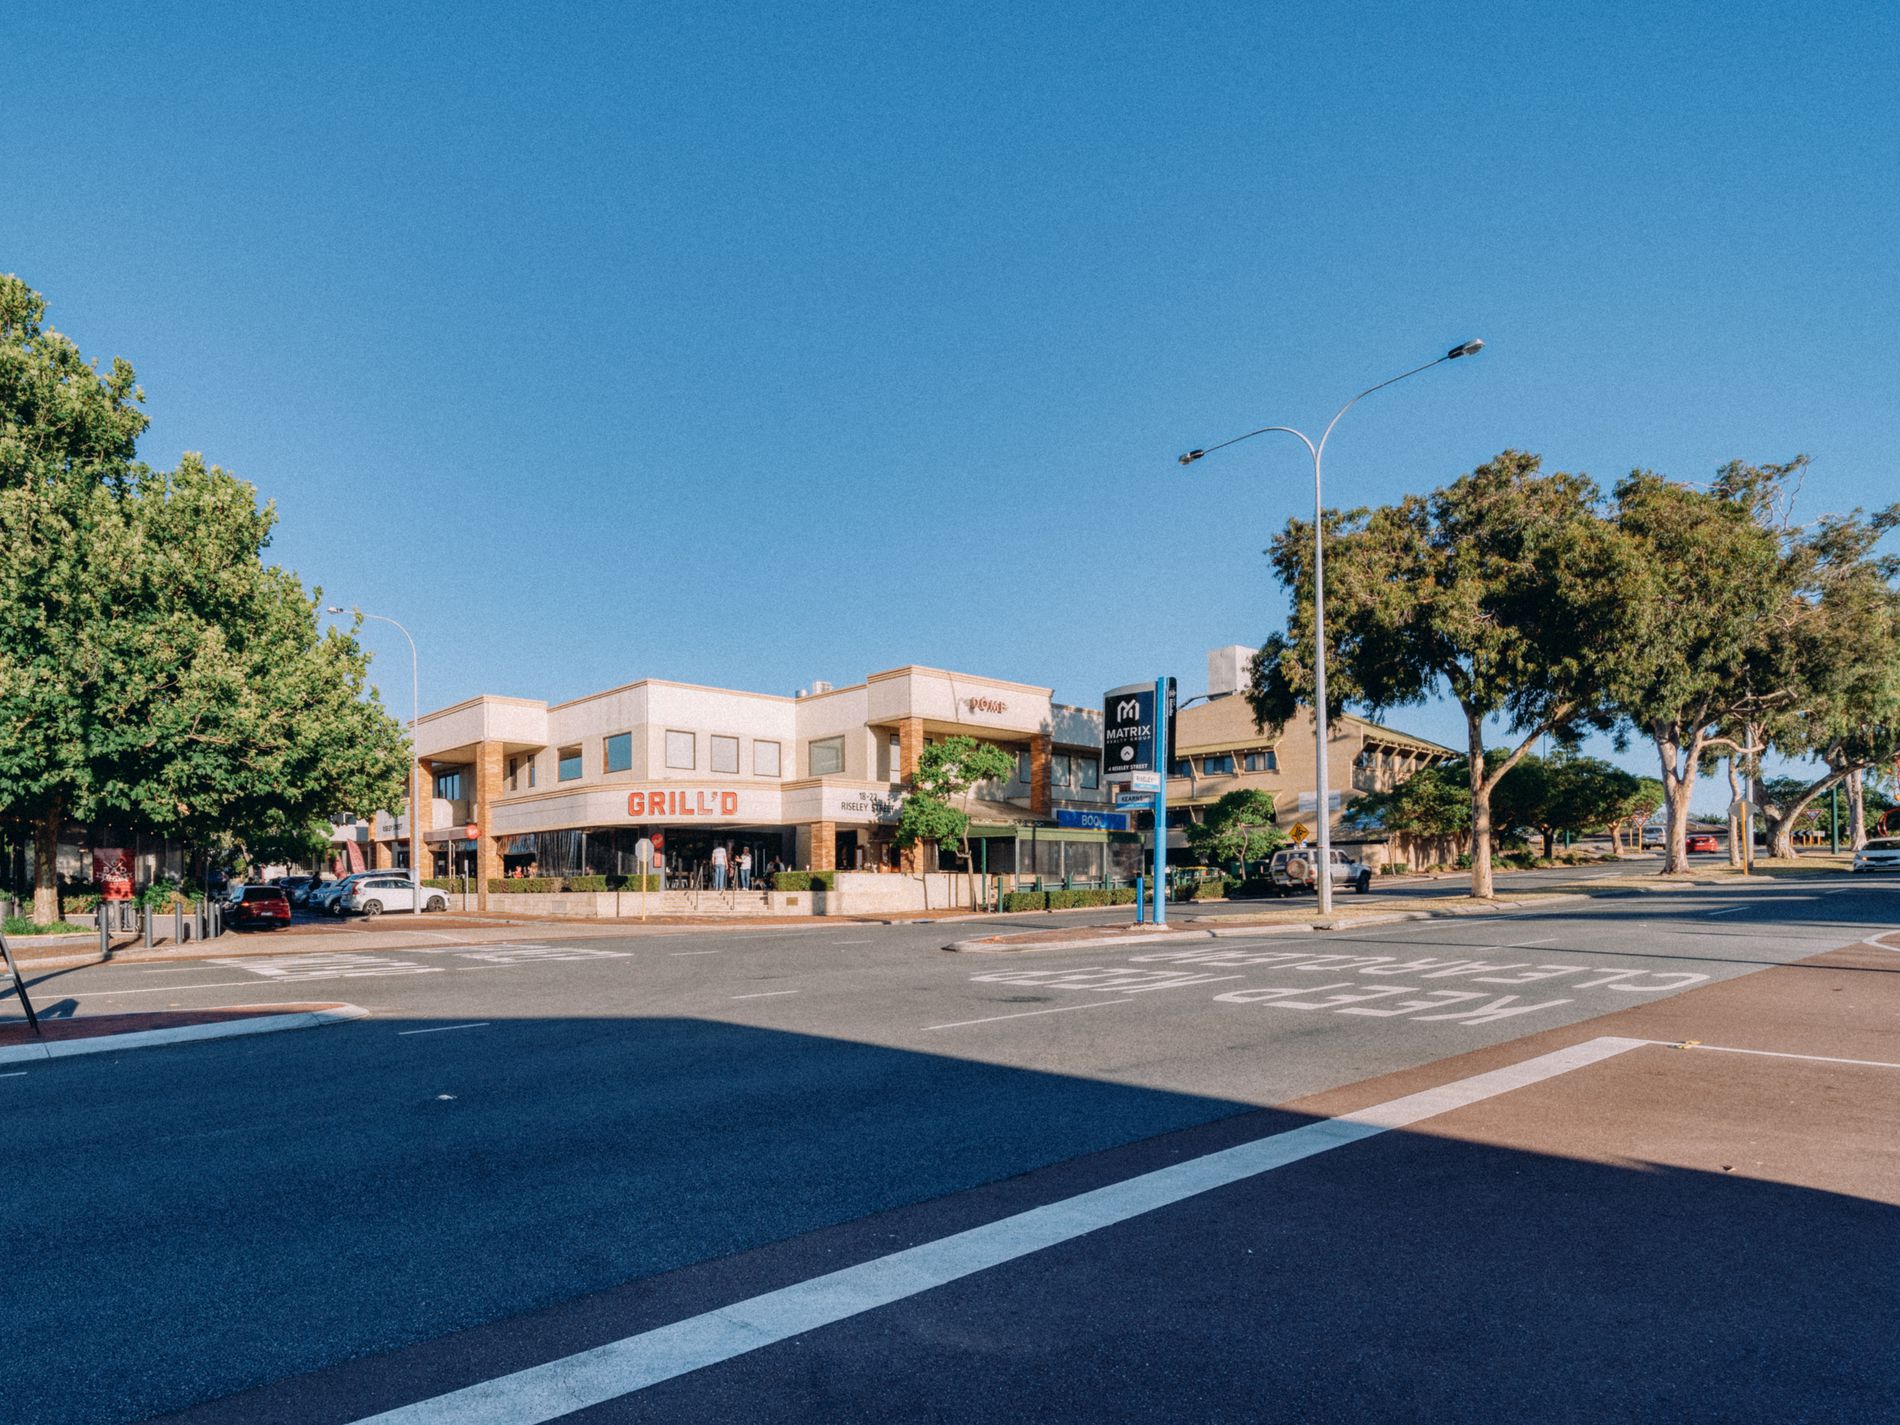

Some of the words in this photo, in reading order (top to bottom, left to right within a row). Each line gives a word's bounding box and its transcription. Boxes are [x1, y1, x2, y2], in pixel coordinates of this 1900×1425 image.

[1106, 725, 1150, 739] MATRIX
[628, 791, 738, 816] GRILL'D
[841, 802, 868, 811] RISELEY
[970, 967, 1246, 993] KEEP
[1357, 958, 1711, 991] CLEAR
[1213, 983, 1575, 1025] KEEP
